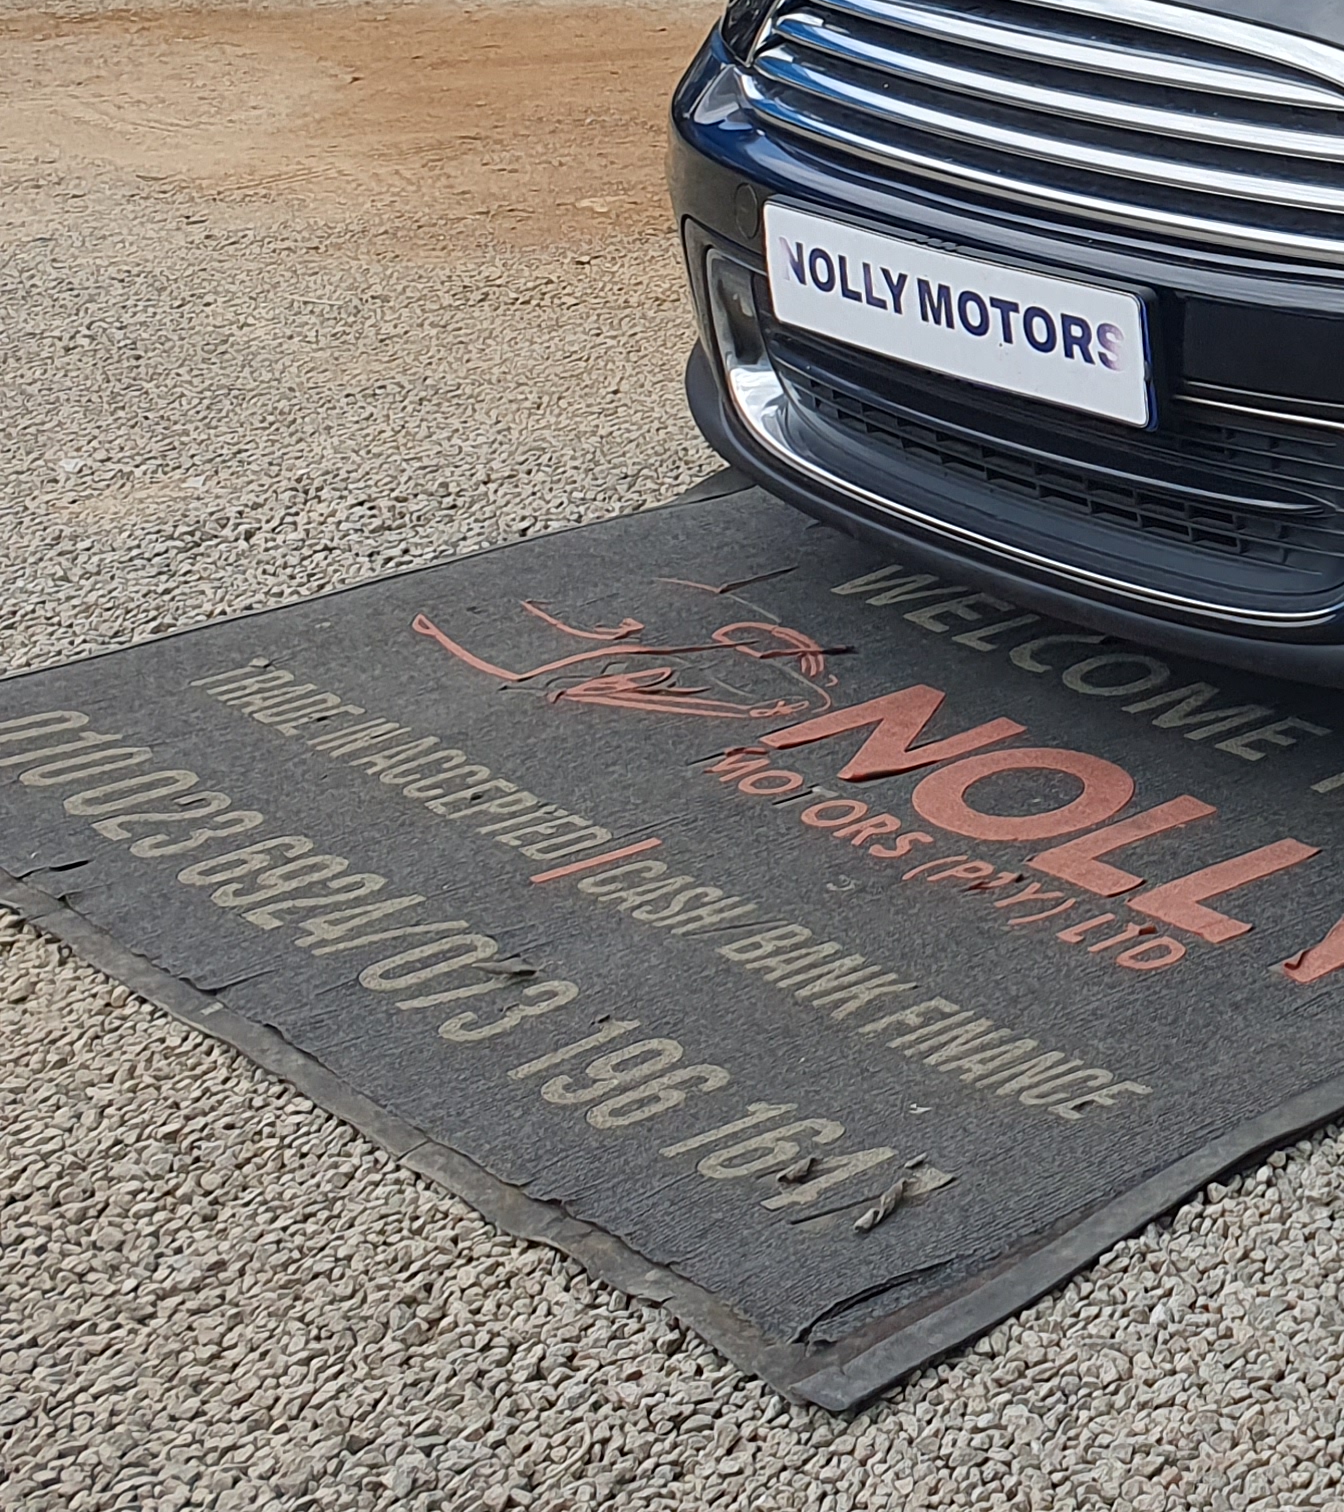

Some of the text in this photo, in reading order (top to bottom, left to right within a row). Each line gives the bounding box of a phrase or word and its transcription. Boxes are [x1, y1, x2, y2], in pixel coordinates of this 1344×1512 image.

[778, 236, 1126, 373] NOLLY MOTORS
[188, 656, 366, 737] TRADE
[830, 564, 1332, 762] WELCOME
[305, 717, 412, 759] IN
[348, 735, 614, 862] ACCEPTED
[1055, 912, 1188, 971] LTD
[857, 995, 1153, 1120] FINANCE
